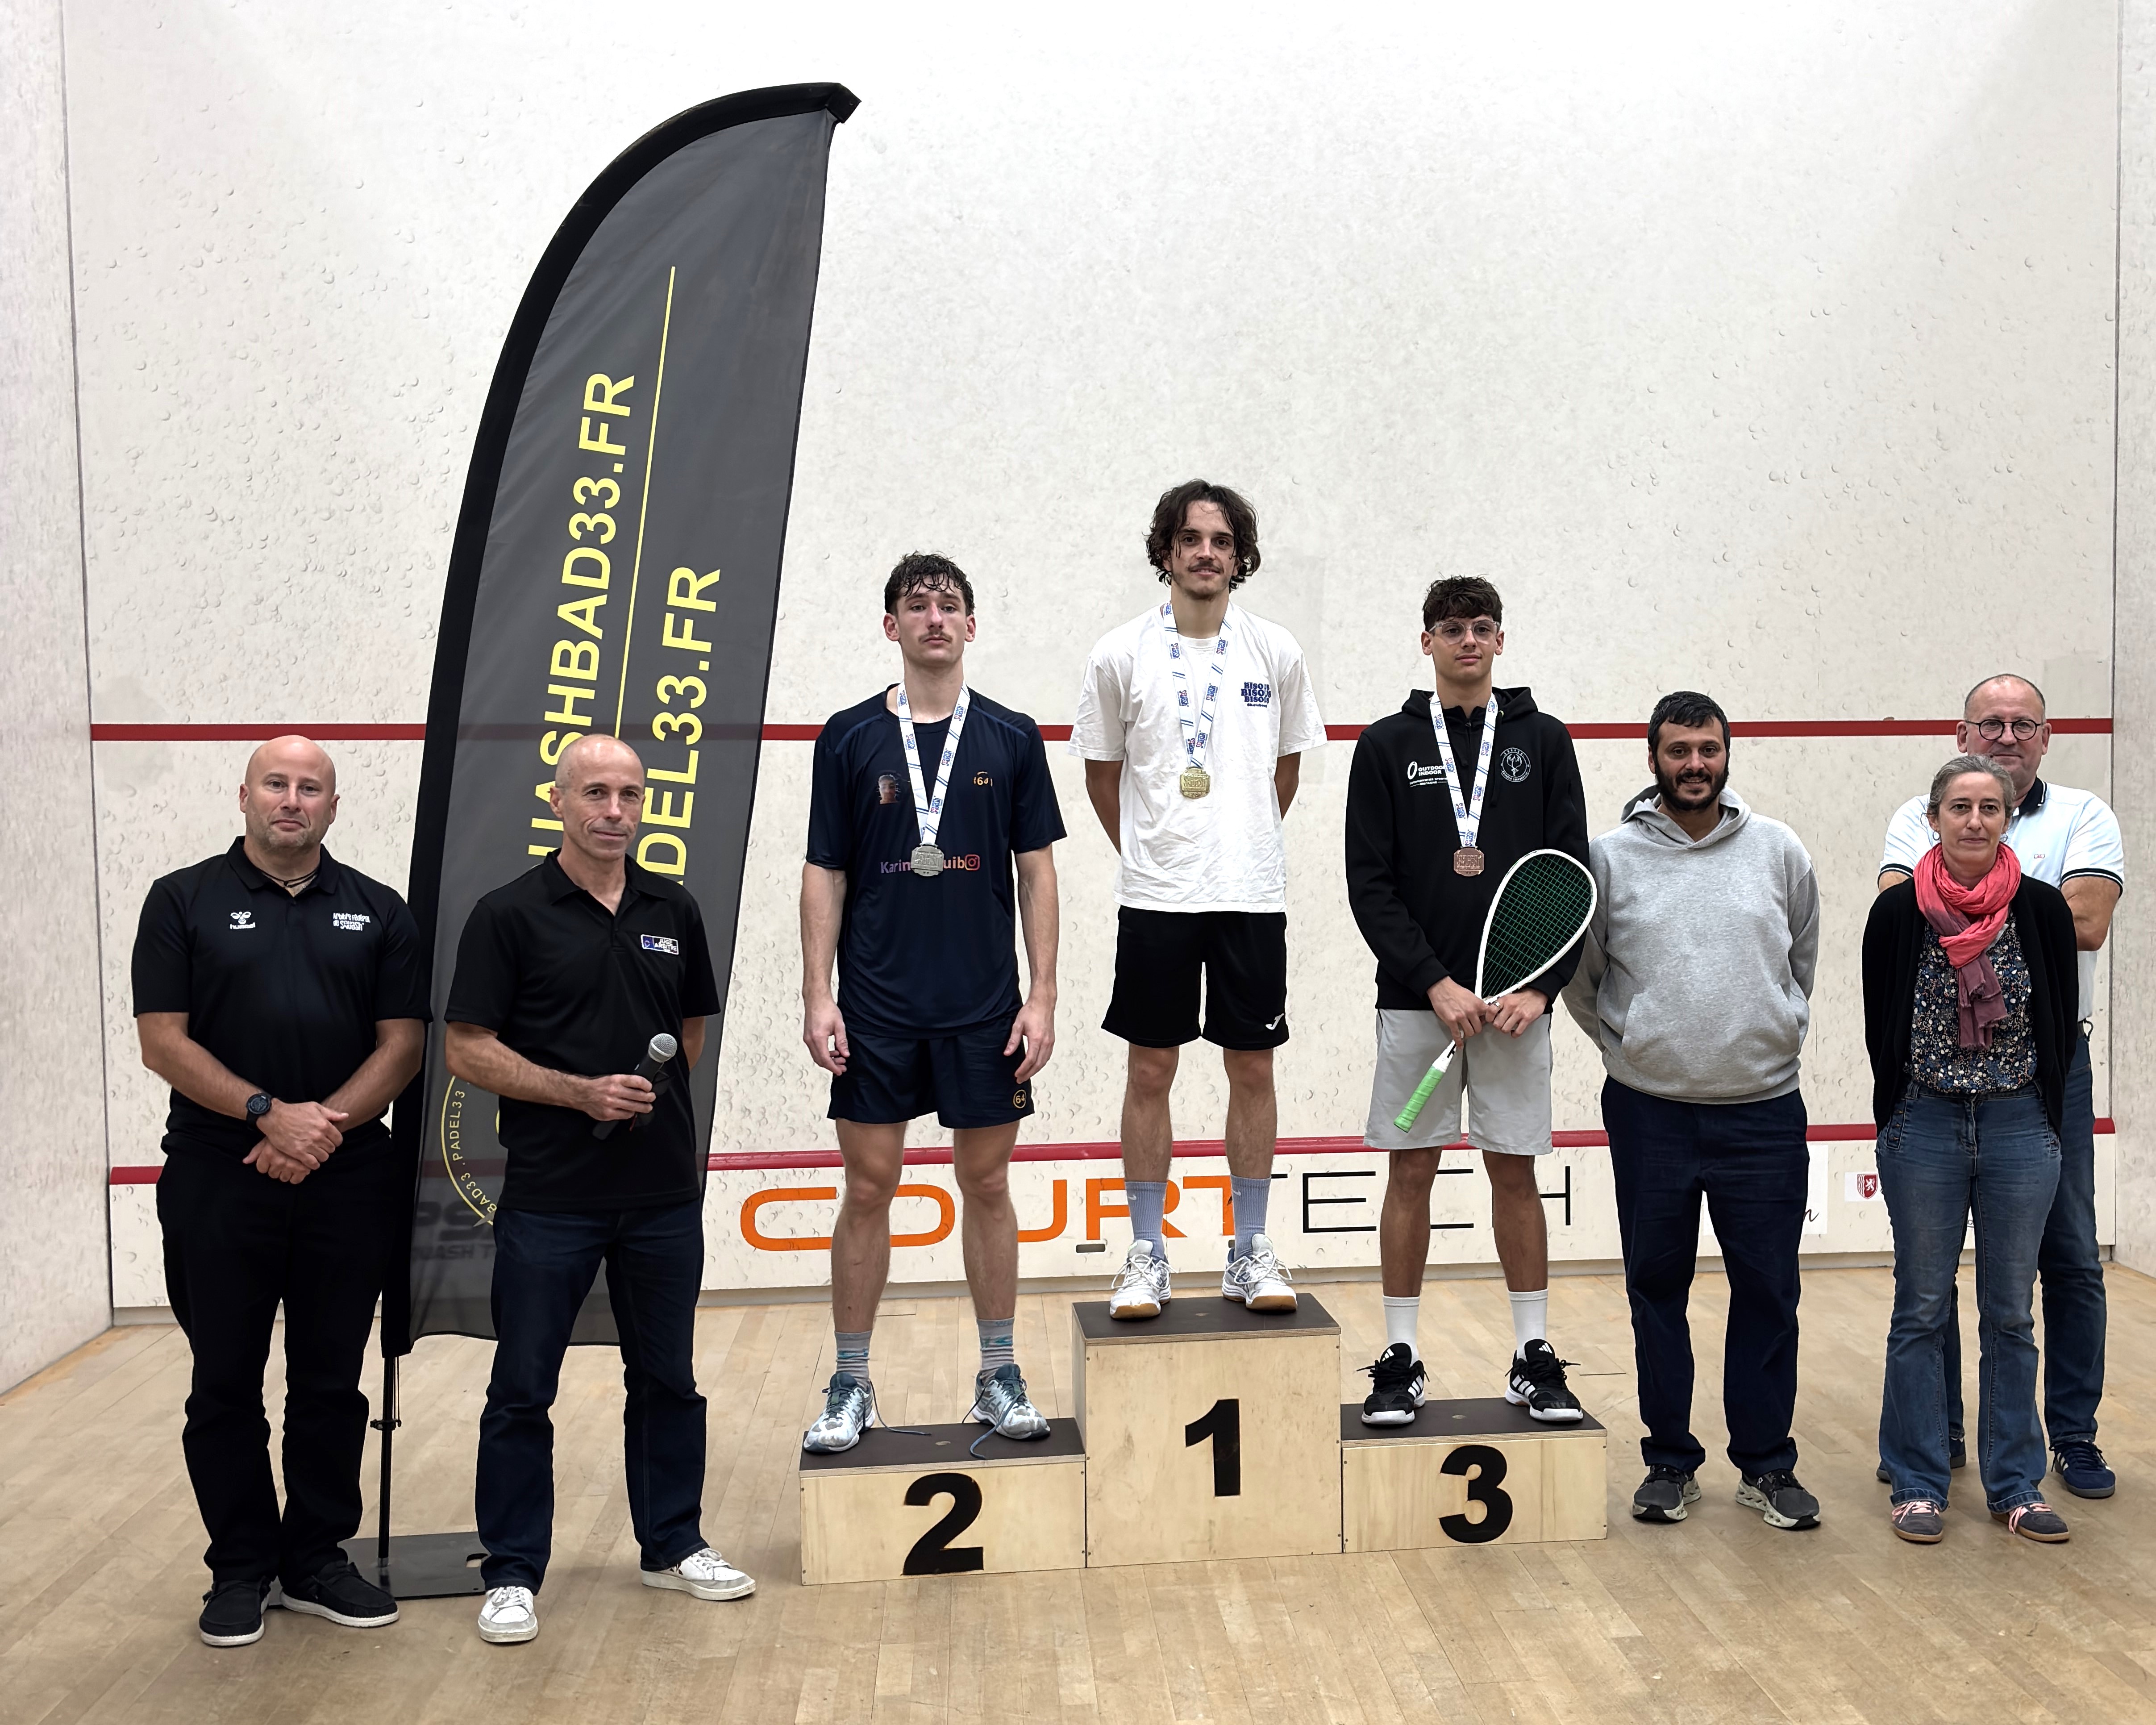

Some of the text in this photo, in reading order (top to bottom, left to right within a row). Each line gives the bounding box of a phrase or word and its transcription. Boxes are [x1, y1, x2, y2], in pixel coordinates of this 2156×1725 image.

[636, 567, 720, 886] DEL33.FR
[1241, 688, 1271, 698] BISOUS
[1244, 682, 1269, 691] BISOUS
[449, 1091, 465, 1161] PADEL33
[460, 1172, 497, 1213] BAD33
[1185, 1398, 1240, 1497] 1
[901, 1472, 984, 1576] 2
[1439, 1445, 1513, 1544] 3
